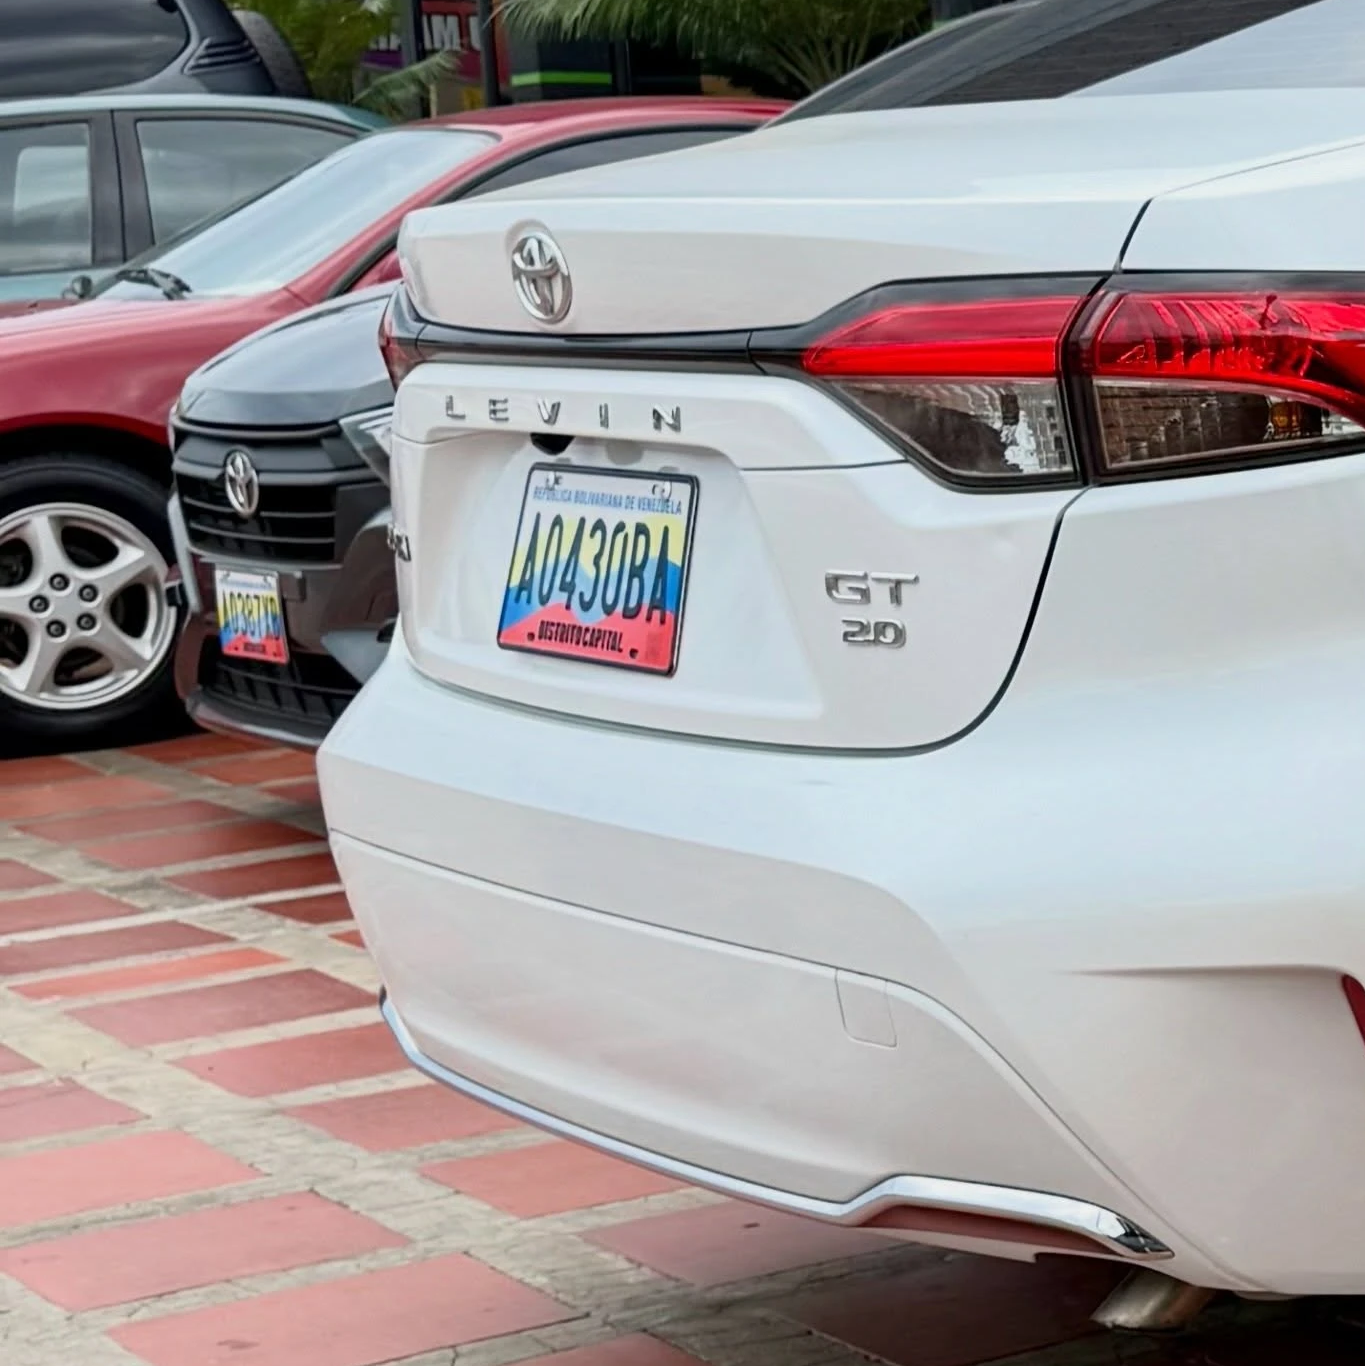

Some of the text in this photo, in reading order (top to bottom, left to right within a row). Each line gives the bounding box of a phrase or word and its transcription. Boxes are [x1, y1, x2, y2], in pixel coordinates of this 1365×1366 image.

[445, 395, 682, 433] LEVIN
[573, 489, 623, 509] BOLIVARIANA
[625, 494, 635, 510] DE
[637, 496, 682, 515] VENEZUELA
[825, 569, 920, 607] GT
